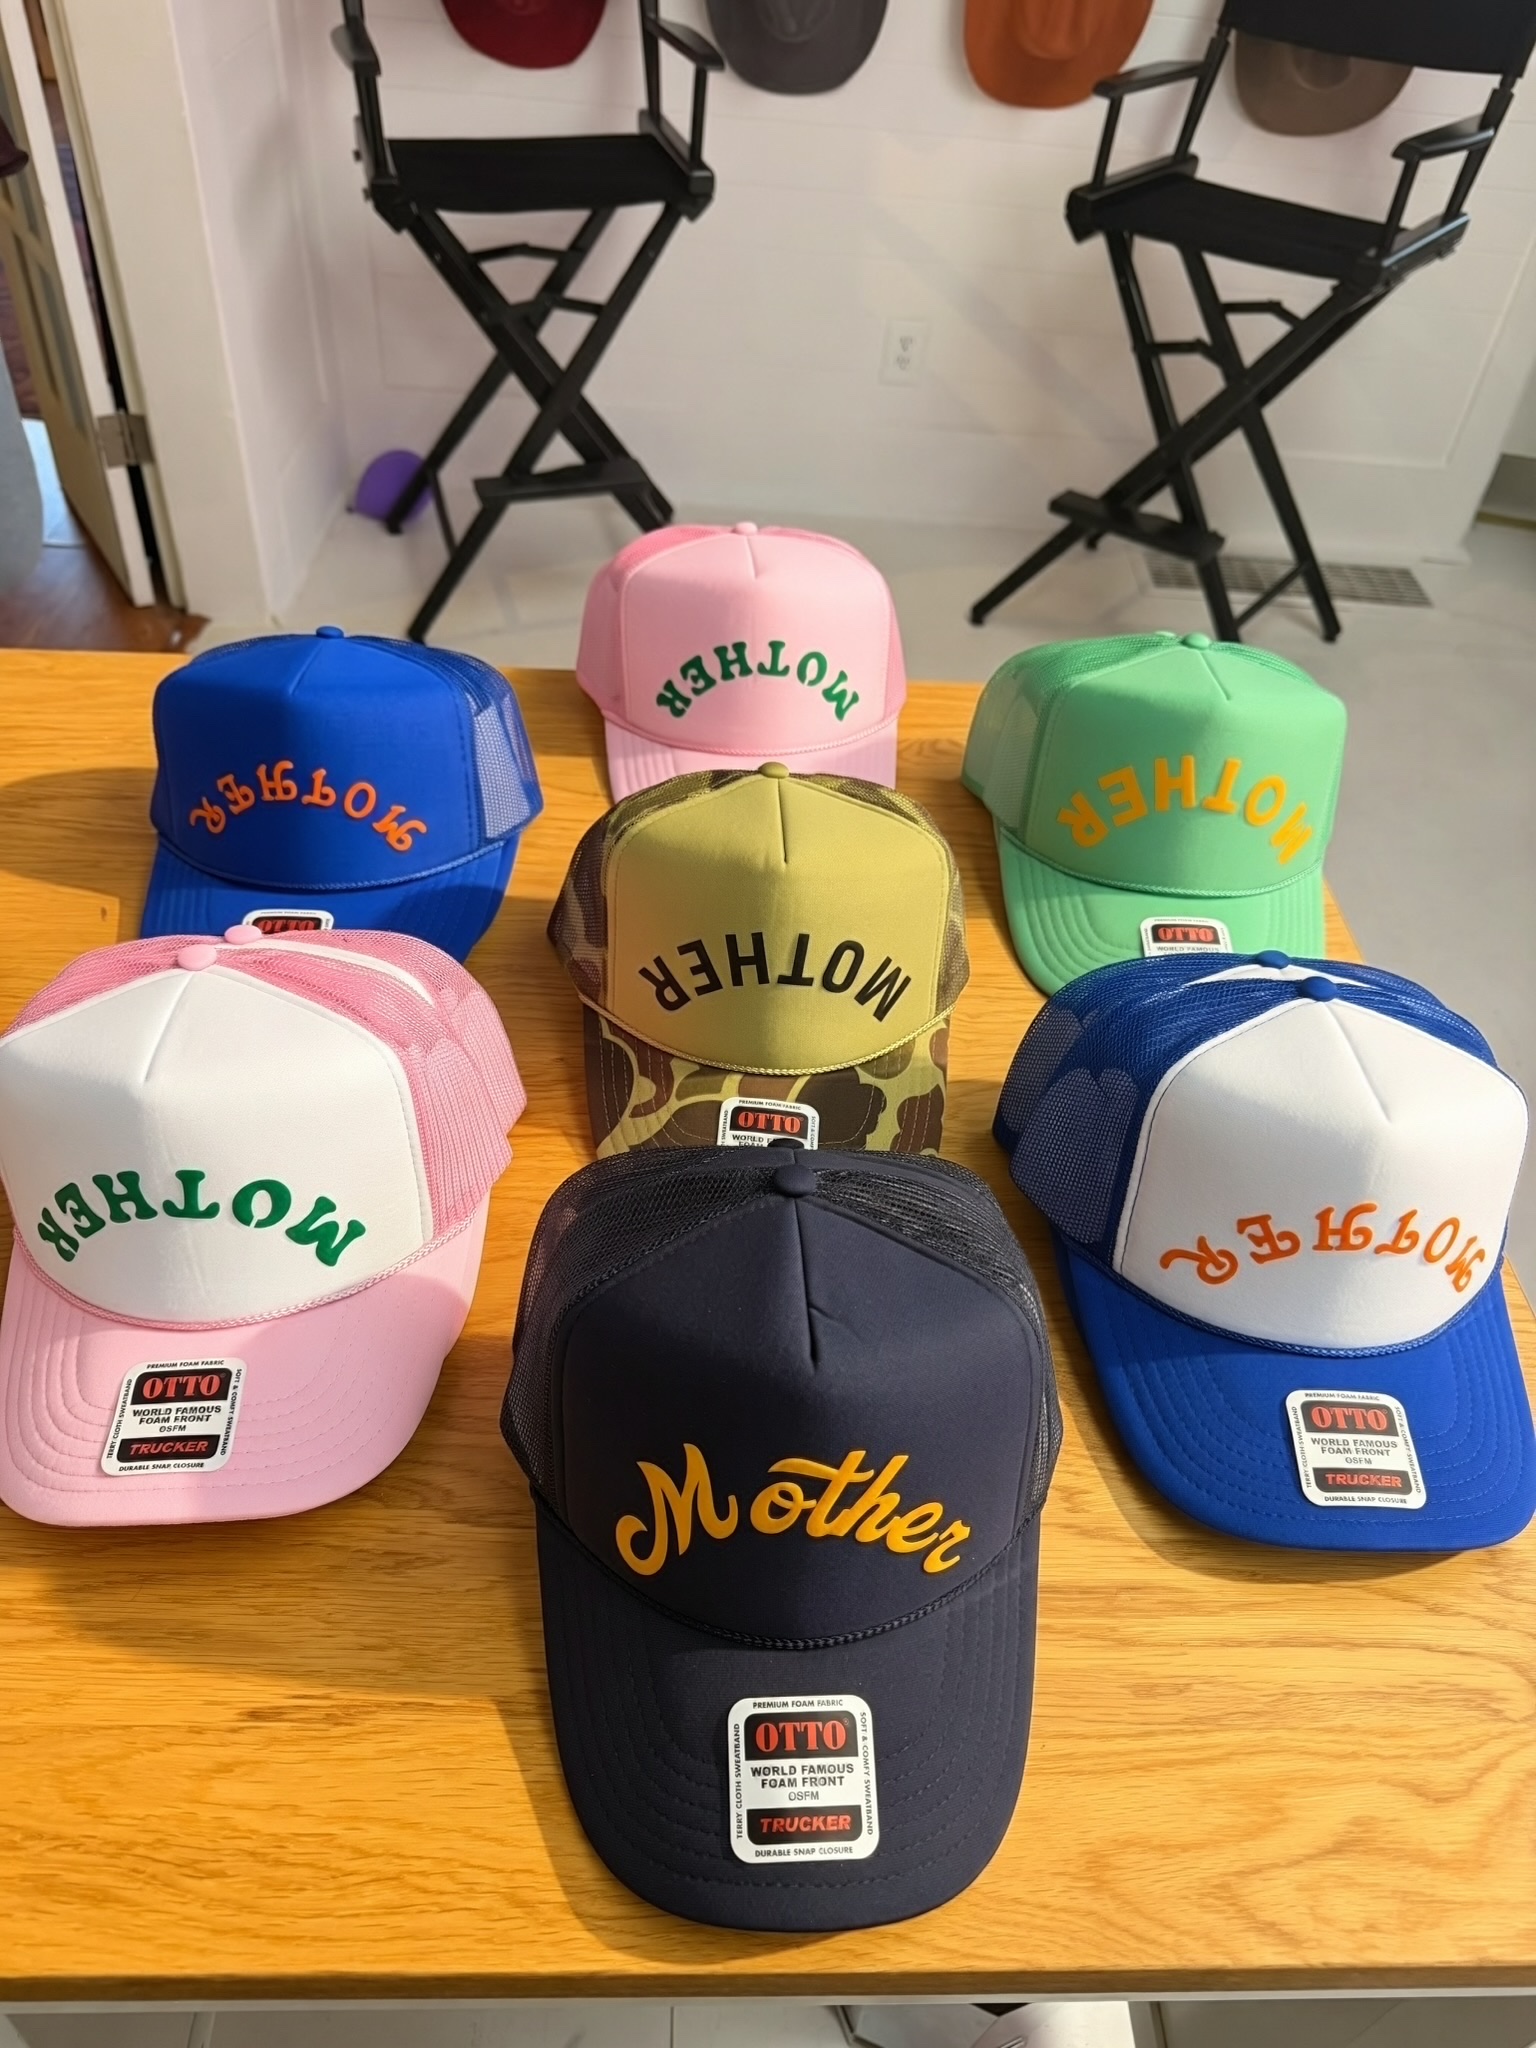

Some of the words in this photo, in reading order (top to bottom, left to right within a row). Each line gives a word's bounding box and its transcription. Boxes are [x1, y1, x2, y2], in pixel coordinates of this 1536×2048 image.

[655, 640, 860, 722] MOTHER
[189, 760, 428, 851] MOTHER
[1056, 754, 1313, 865] MOTHER
[1158, 927, 1214, 942] OTTO
[638, 931, 912, 1023] MOTHER
[738, 1111, 801, 1134] OTTO
[732, 1134, 764, 1143] WORLD
[37, 1169, 366, 1267] MOTHER
[1159, 1203, 1486, 1293] MOTHER
[146, 1362, 178, 1370] PREMIUM
[143, 1374, 221, 1399] OTTO
[132, 1407, 172, 1417] WORLD
[175, 1405, 222, 1414] FAMOUS
[1311, 1406, 1388, 1431] OTTO
[138, 1416, 171, 1425] FOAM
[173, 1414, 212, 1423] FRONT
[112, 1418, 123, 1439] CLOTH
[159, 1424, 187, 1433] OSFM
[130, 1441, 209, 1455] TRUCKER
[1310, 1437, 1350, 1447] WORLD
[1353, 1439, 1398, 1449] FAMOUS
[1320, 1447, 1351, 1455] FOAM
[1355, 1447, 1391, 1457] FRONT
[118, 1464, 149, 1472] DURABLE
[1345, 1457, 1372, 1465] OSFM
[1324, 1473, 1402, 1488] TRUCKER
[615, 1443, 971, 1576] Mother
[753, 1701, 789, 1709] PREMIUM
[791, 1700, 815, 1708] FOAM
[817, 1699, 844, 1707] FABRIC
[755, 1720, 846, 1753] OTTO
[733, 1723, 742, 1778] SWEATBAND
[862, 1745, 870, 1777] COMFY
[750, 1765, 797, 1777] WORLD
[801, 1763, 854, 1775] FAMOUS
[761, 1778, 797, 1789] FOAM
[802, 1776, 845, 1787] FRONT
[735, 1780, 743, 1810] CLOTH
[788, 1790, 820, 1801] OSFM
[864, 1779, 874, 1836] SWEATBAND
[760, 1815, 852, 1833] TRUCKER
[755, 1849, 791, 1858] DURABLE
[794, 1848, 816, 1856] SNAP
[819, 1846, 853, 1855] CLOSURE
